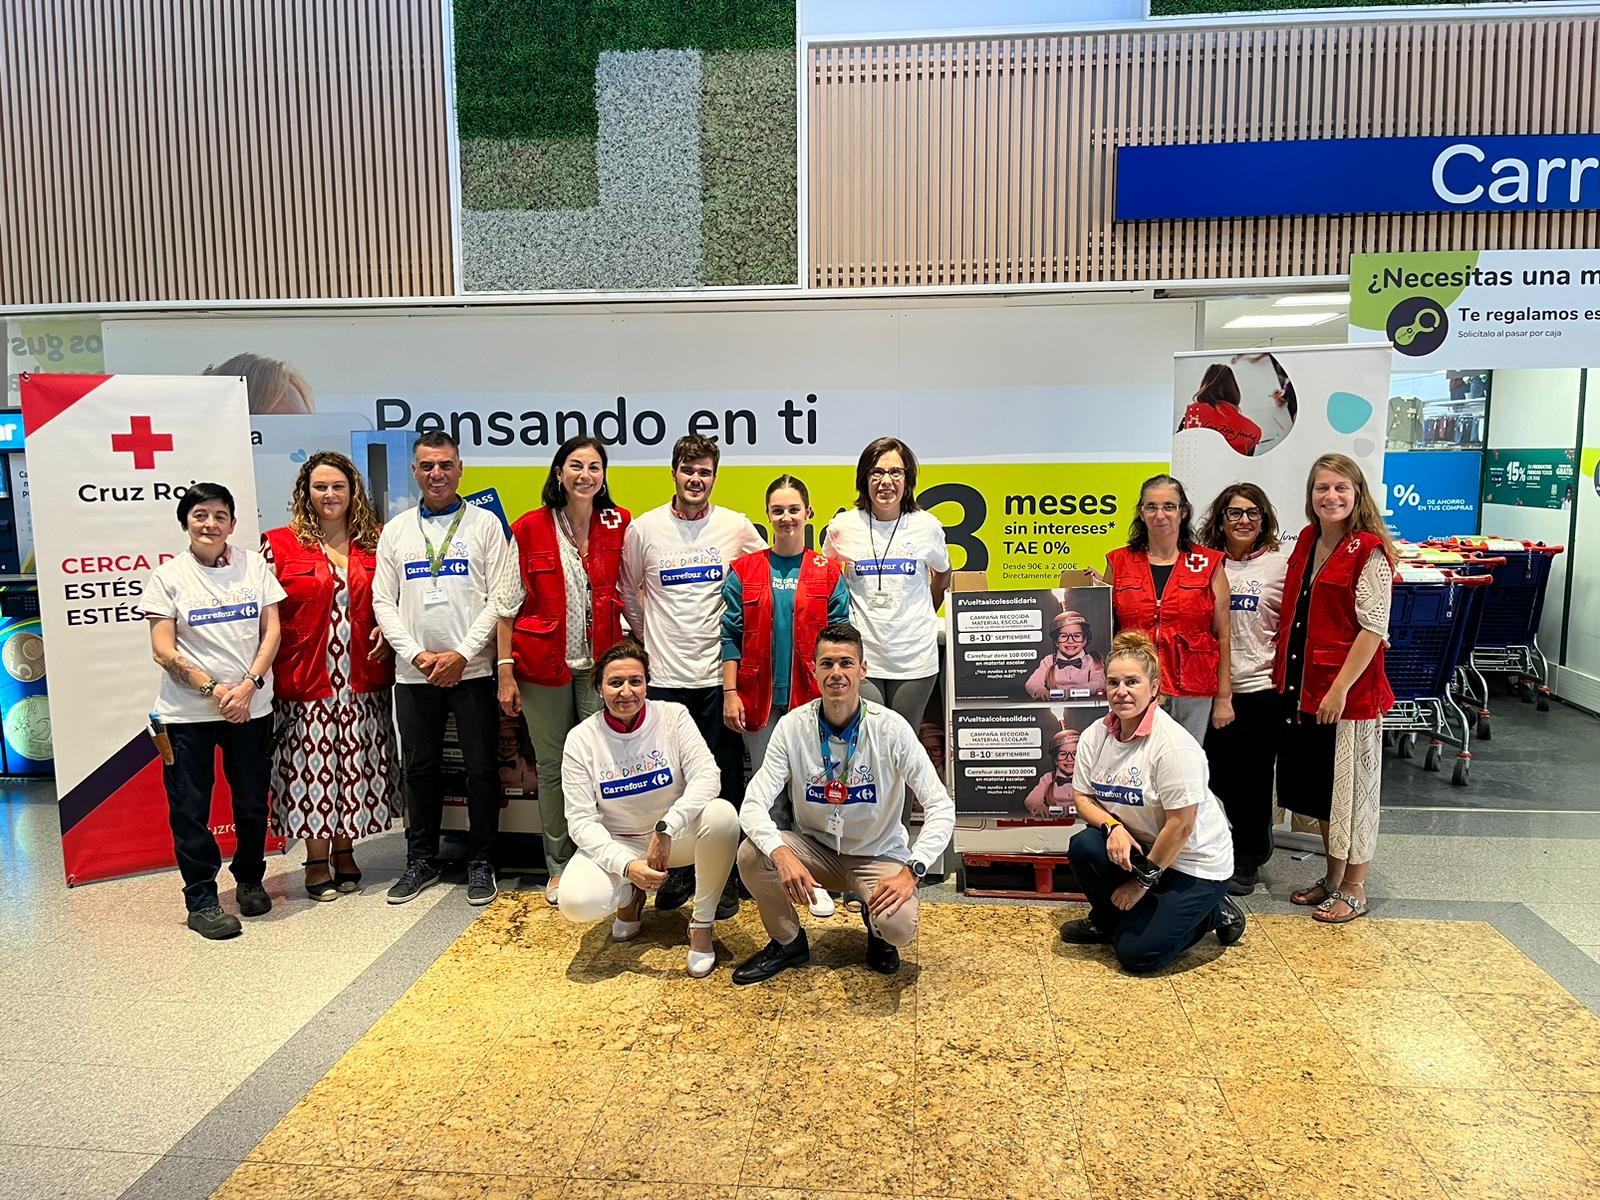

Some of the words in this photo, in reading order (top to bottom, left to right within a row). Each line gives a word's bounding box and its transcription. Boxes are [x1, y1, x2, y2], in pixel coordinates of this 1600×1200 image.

[1431, 143, 1600, 205] Carr
[1368, 265, 1513, 294] ¿Necesitas
[1522, 269, 1570, 285] una
[1458, 308, 1481, 322] Te
[1486, 307, 1579, 324] regalamos
[1458, 330, 1496, 338] Solicítalo
[1496, 330, 1504, 338] al
[1505, 331, 1528, 339] pasar
[1529, 331, 1544, 339] por
[1545, 329, 1562, 338] caja
[687, 408, 757, 446] en
[777, 393, 818, 446] ti
[78, 484, 145, 503] Cruz
[153, 480, 196, 500] Ro
[915, 483, 989, 571] 3
[1004, 493, 1118, 515] meses
[1004, 522, 1028, 535] sin
[1003, 541, 1038, 555] TAE
[1043, 541, 1071, 555] 0%
[62, 555, 151, 574] CERCA
[662, 571, 702, 581] Carrefour
[64, 577, 143, 600] ESTÉS
[957, 597, 1037, 606] #Vueltaalcolesolidaria
[67, 603, 146, 626] ESTÉS
[190, 608, 237, 622] Carrefour
[603, 780, 648, 794] Carrefour
